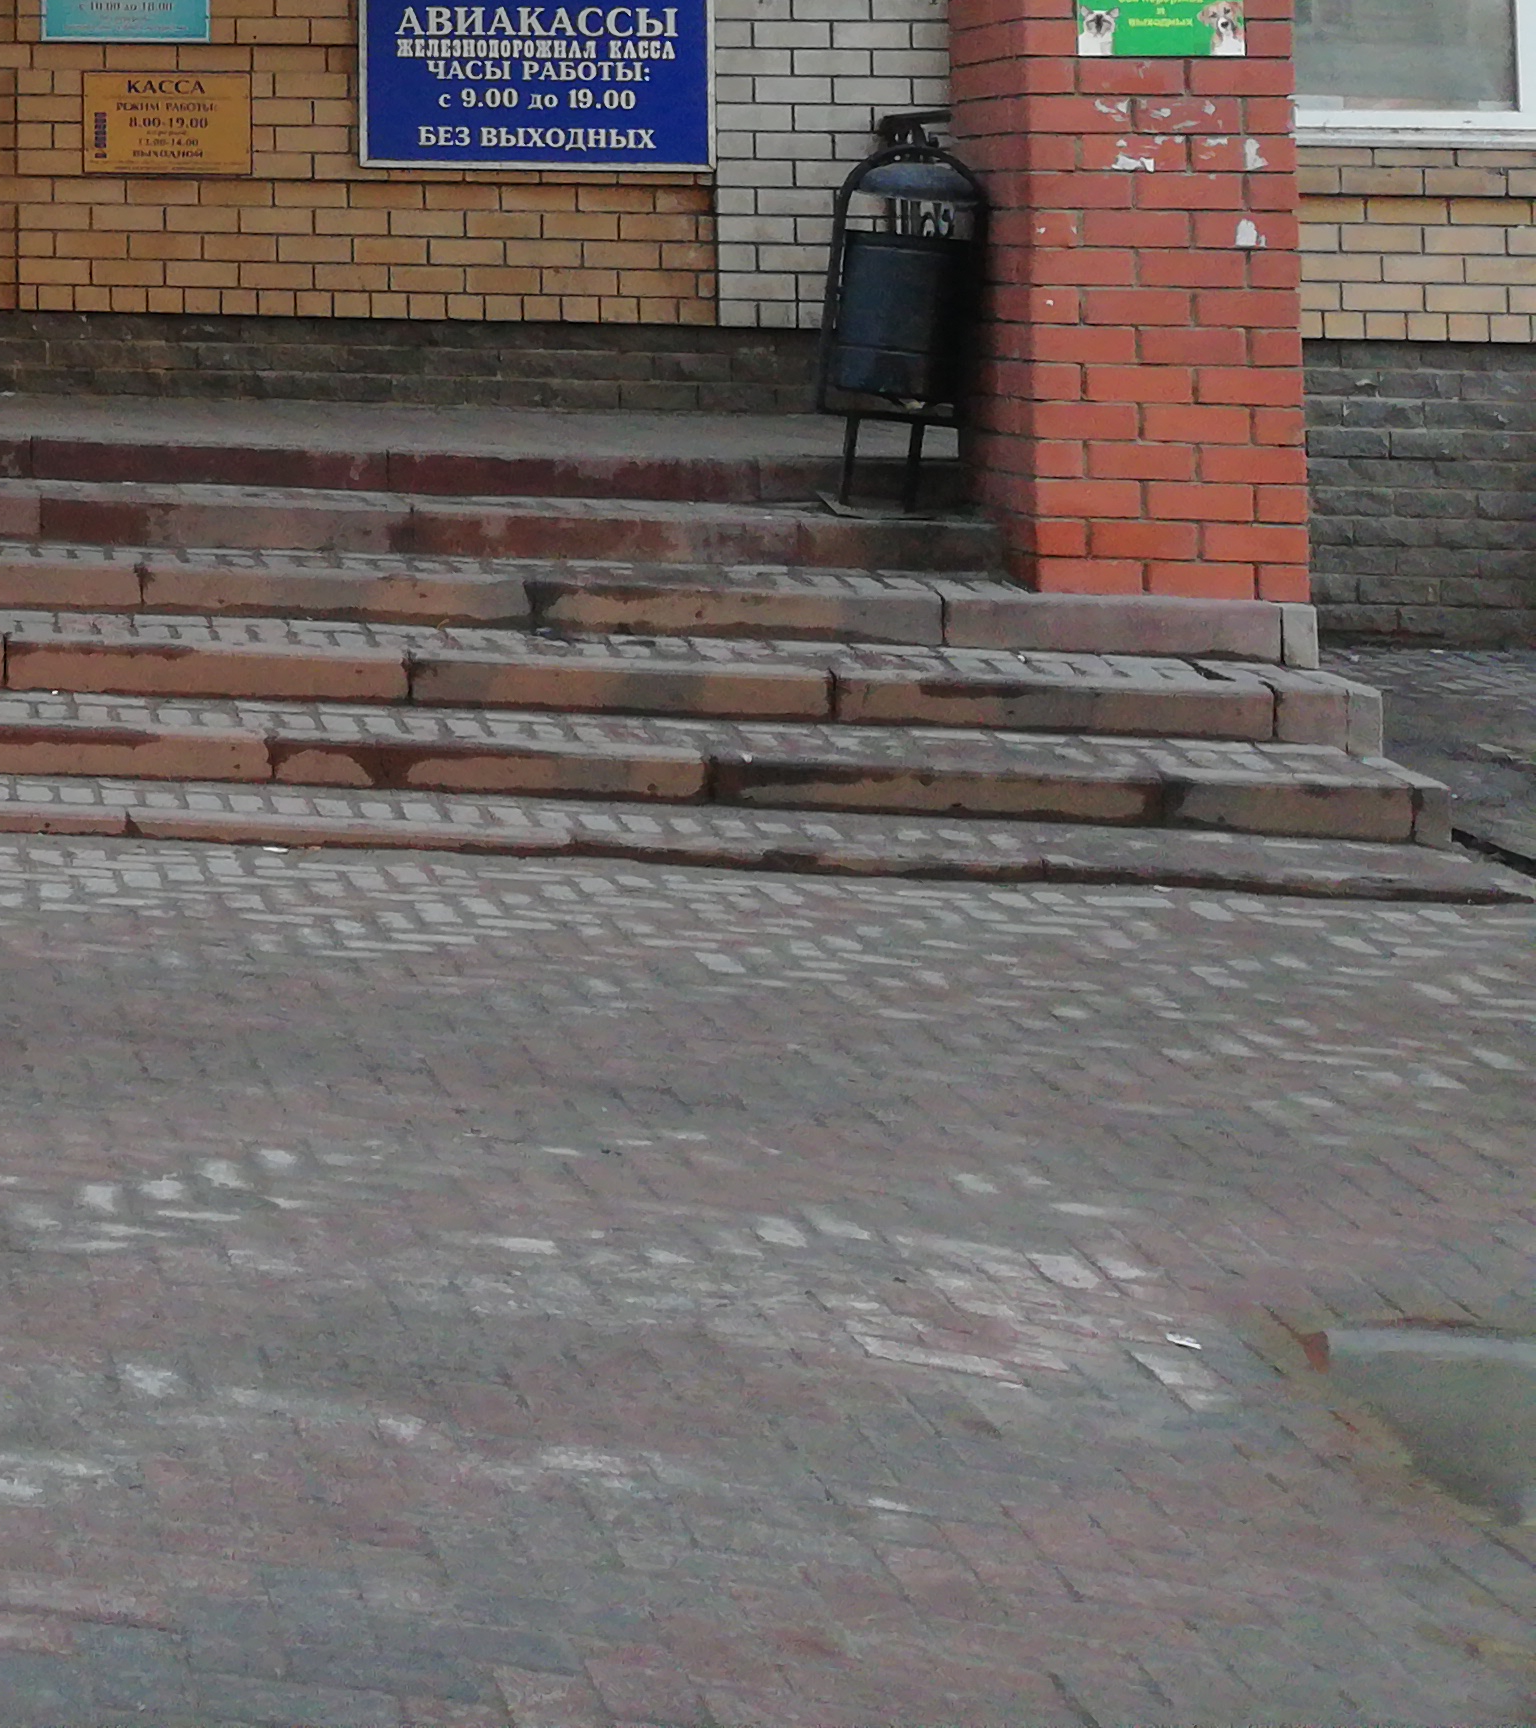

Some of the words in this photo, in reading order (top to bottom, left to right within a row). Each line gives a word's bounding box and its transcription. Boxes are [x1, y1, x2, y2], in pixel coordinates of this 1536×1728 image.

[394, 6, 679, 38] АВИАКАССЫ
[608, 40, 676, 59] КАССА
[426, 60, 512, 81] ЧАСЫ
[521, 61, 652, 82] РАБОТЫ:
[127, 79, 206, 95] КАССА
[438, 93, 452, 108] с
[460, 87, 520, 109] 9.00
[527, 93, 559, 111] до
[567, 88, 636, 110] 19.00
[417, 125, 472, 147] БЕЗ
[480, 127, 657, 152] ВЫХОДНЫХ
